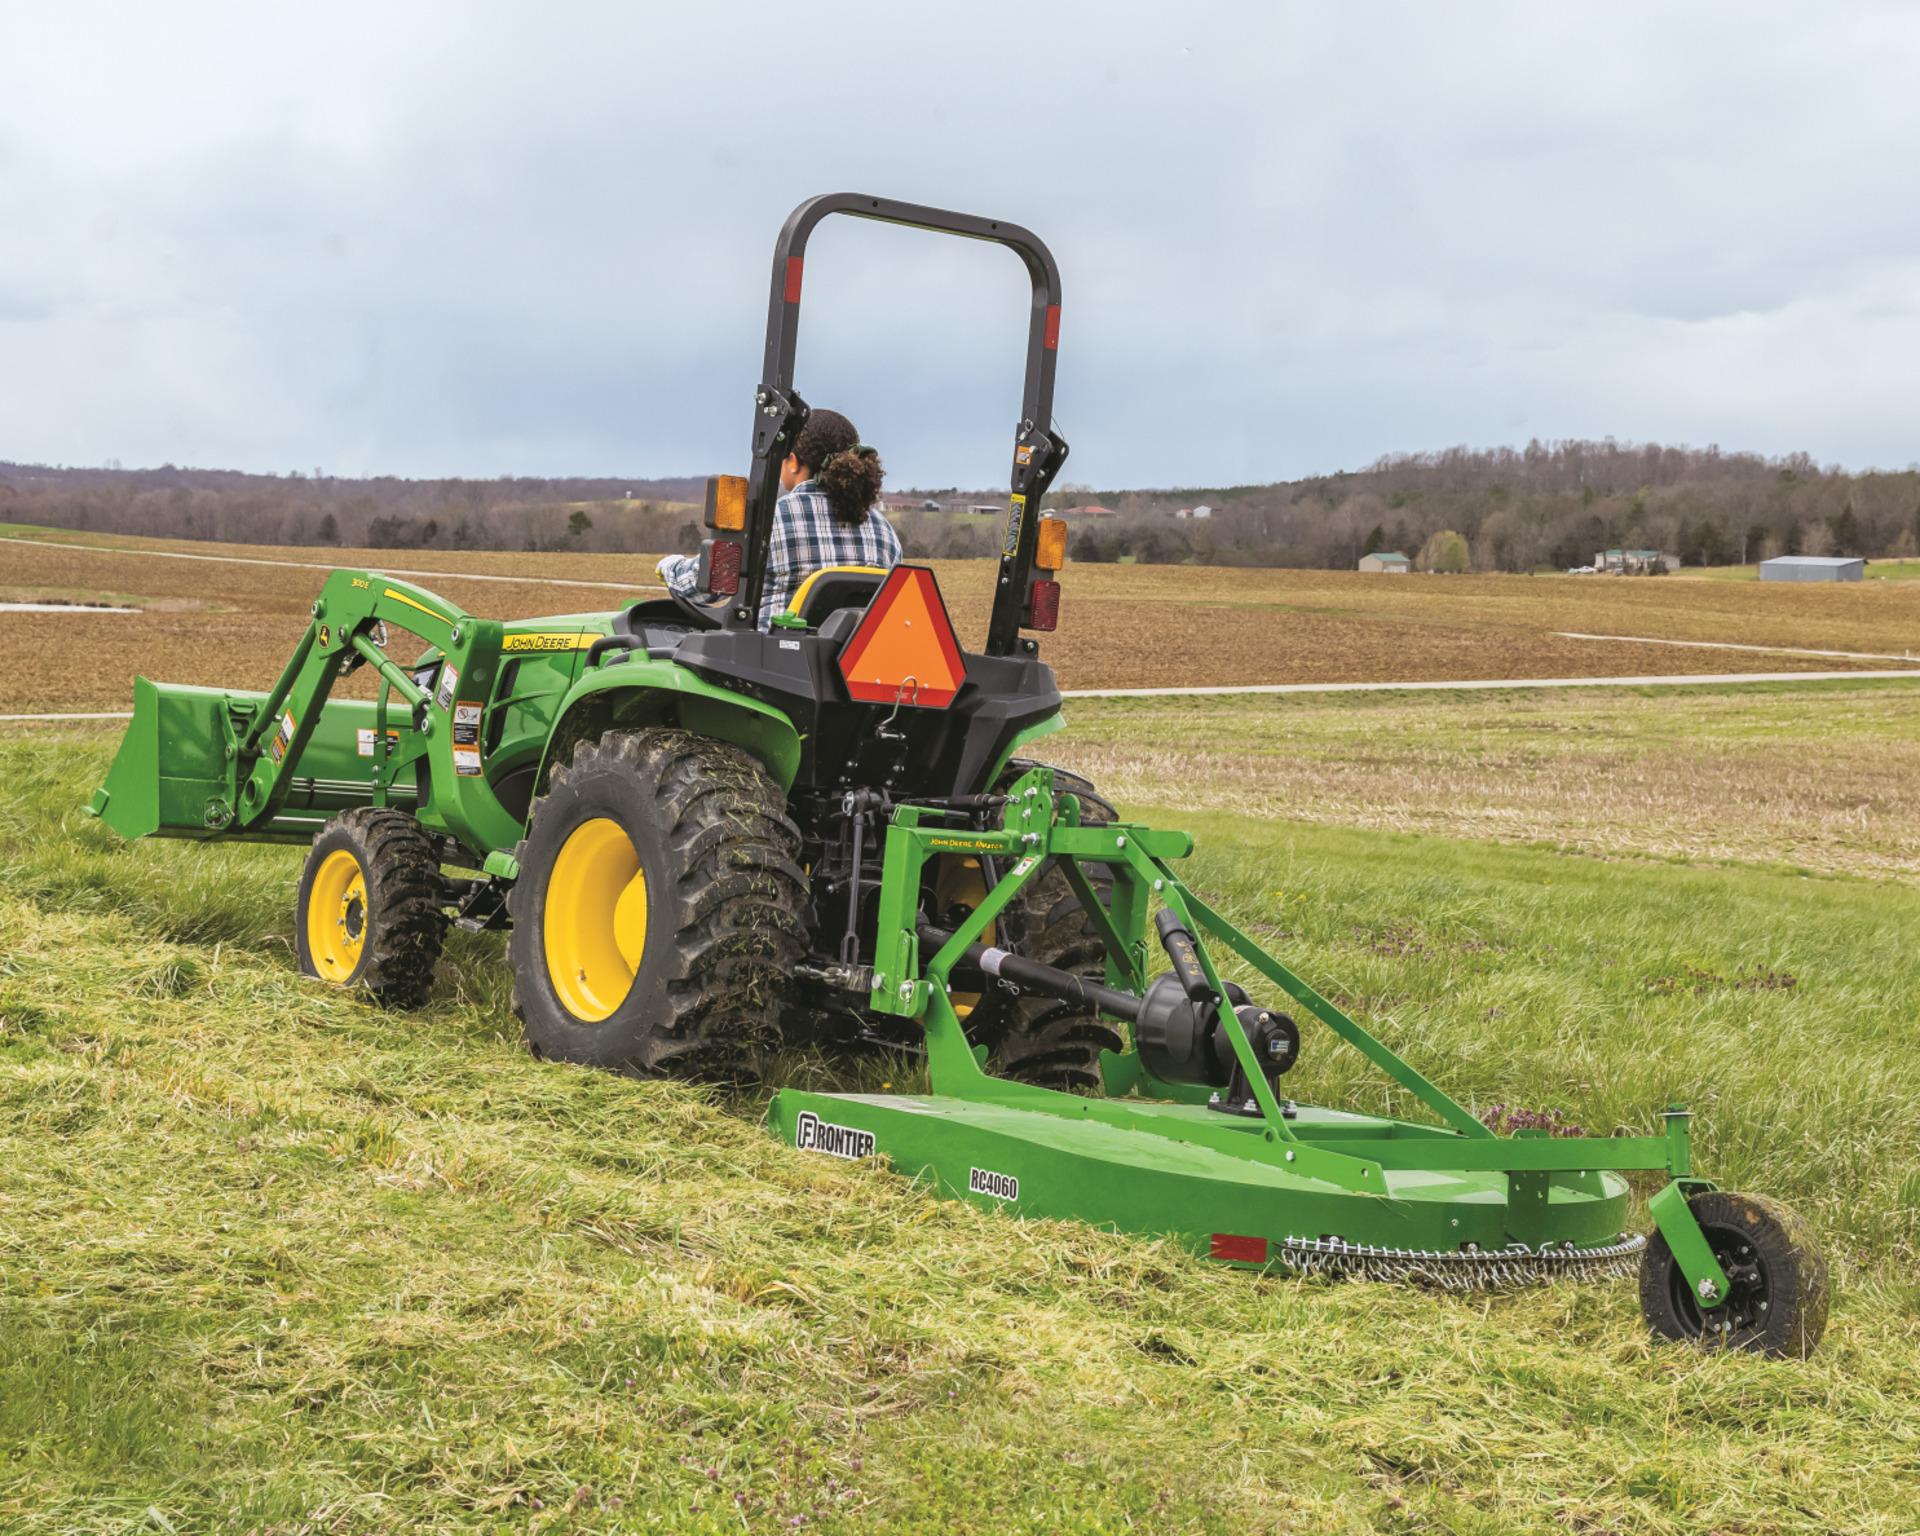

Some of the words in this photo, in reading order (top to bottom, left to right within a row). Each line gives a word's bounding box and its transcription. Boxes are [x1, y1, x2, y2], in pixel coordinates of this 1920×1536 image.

[507, 636, 535, 649] JOHN
[535, 635, 571, 649] DEERE
[797, 1112, 874, 1158] FRONTIER
[971, 1169, 1017, 1199] RC4060
